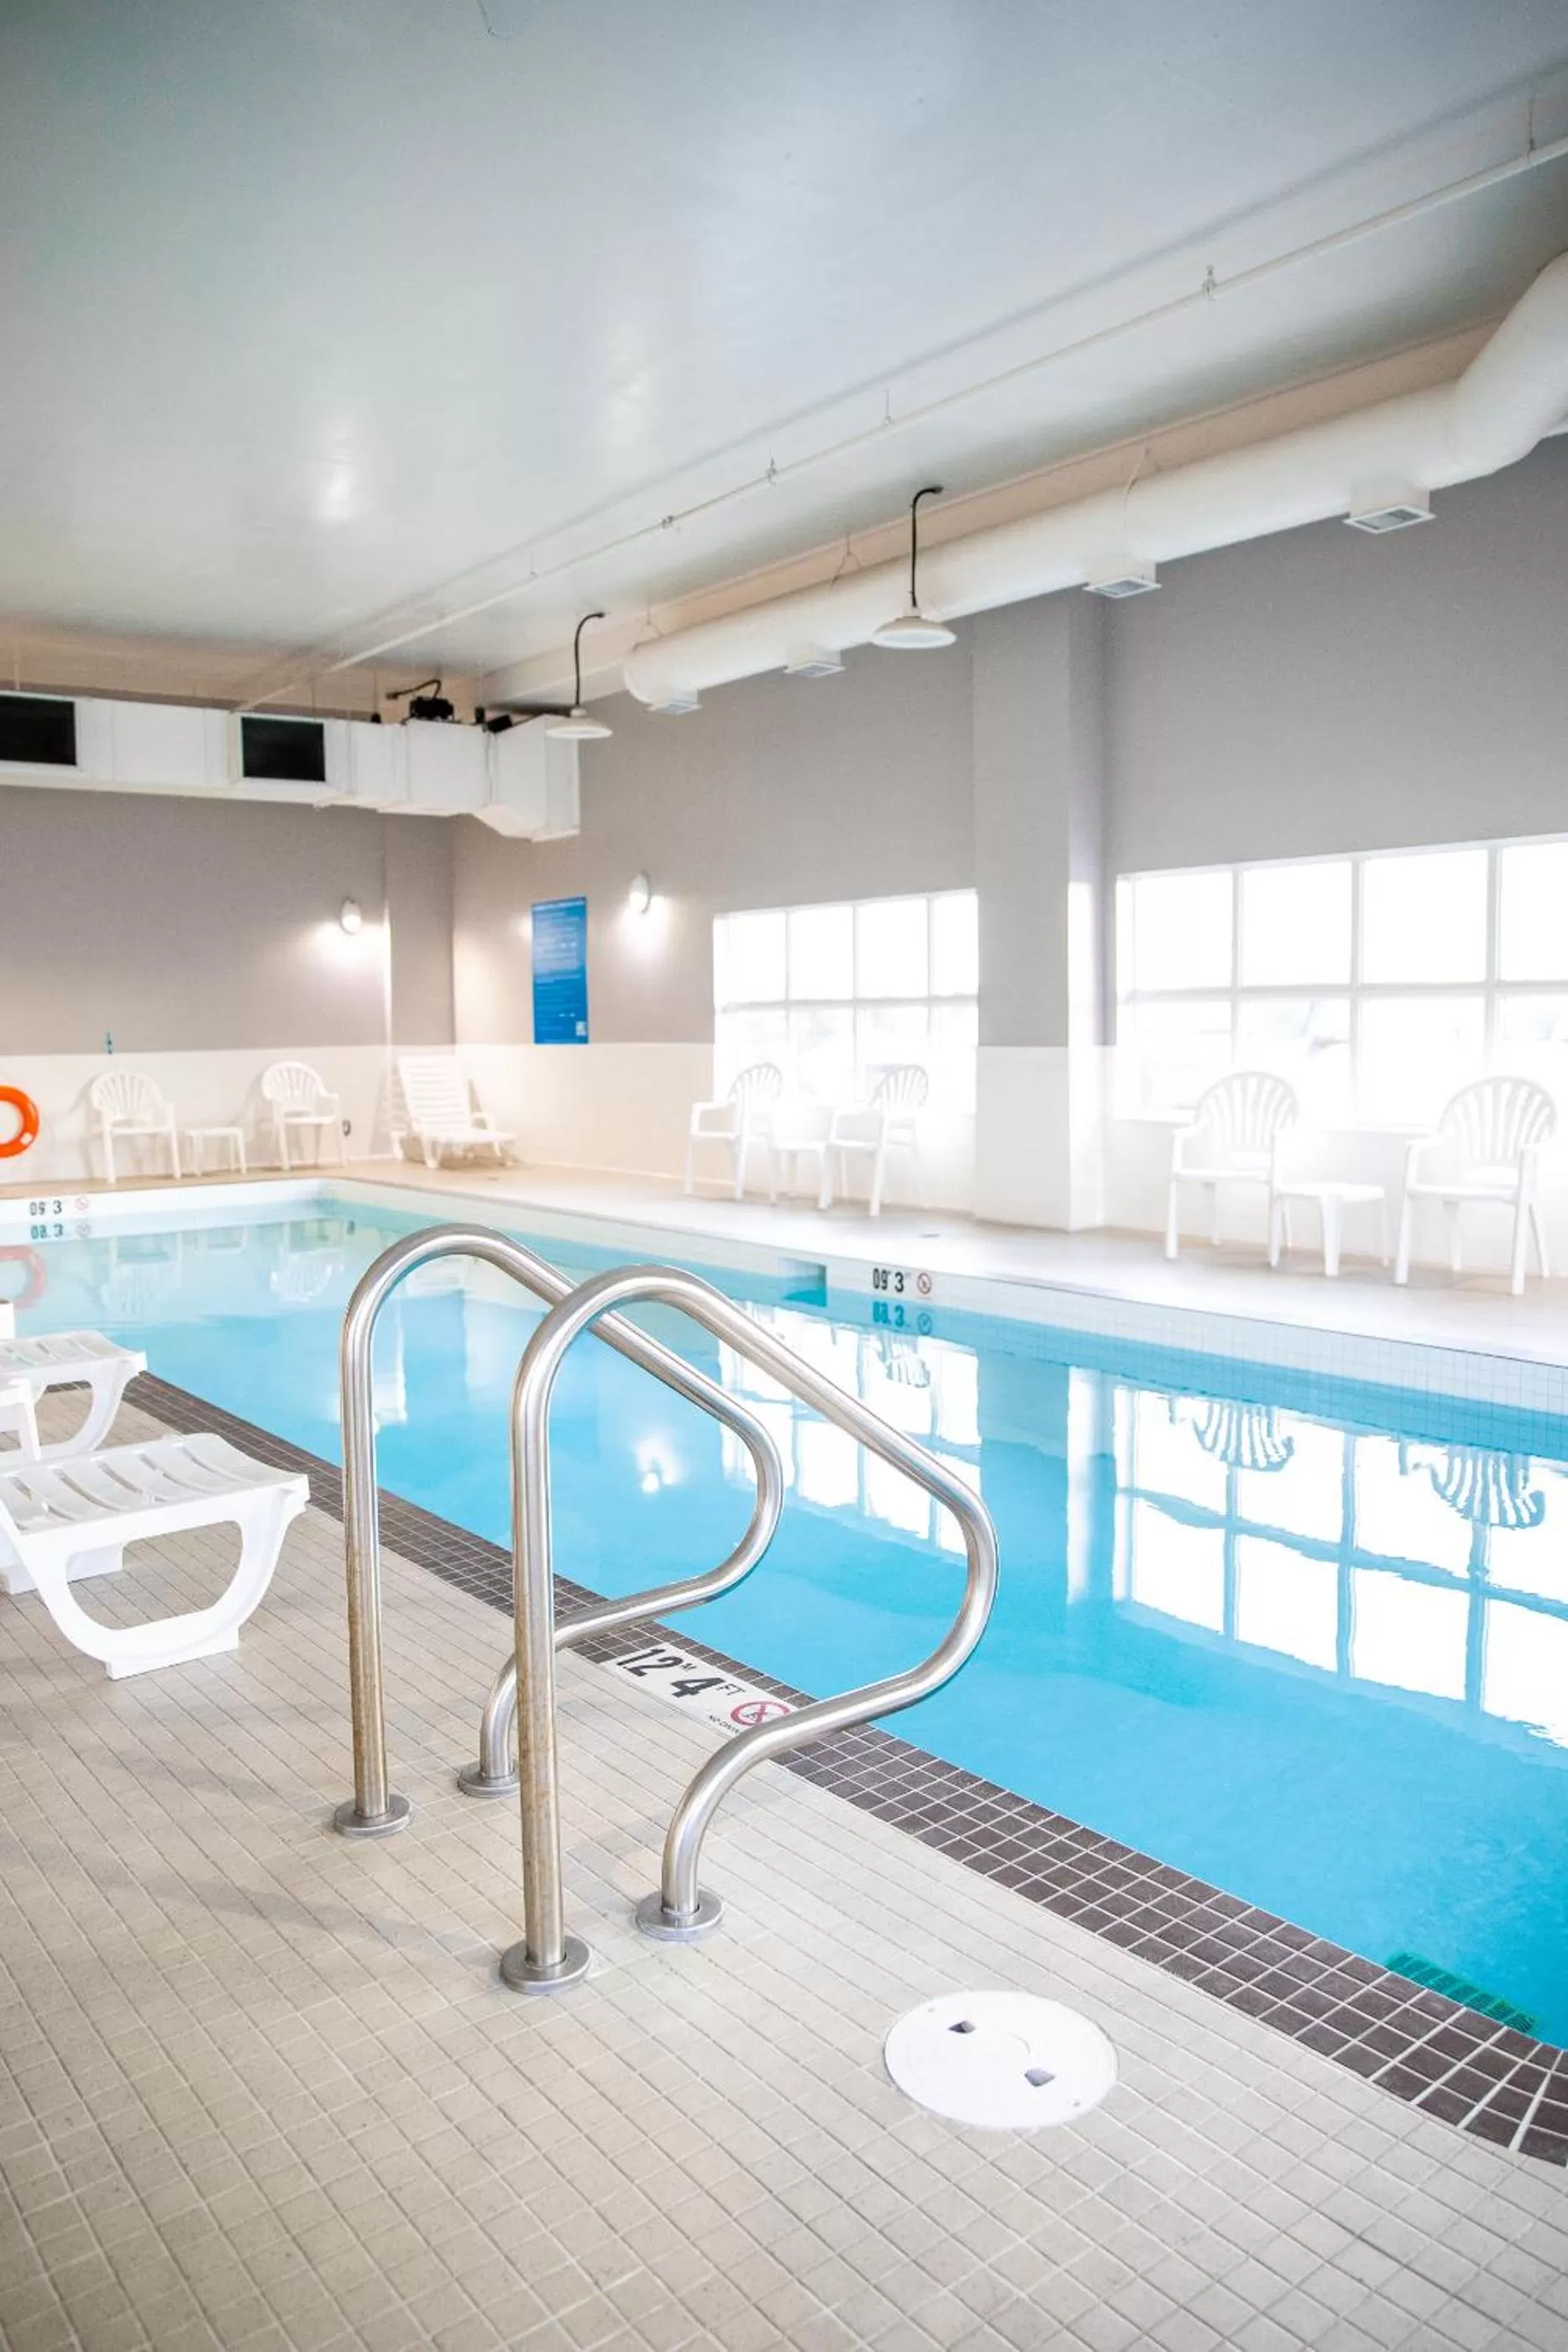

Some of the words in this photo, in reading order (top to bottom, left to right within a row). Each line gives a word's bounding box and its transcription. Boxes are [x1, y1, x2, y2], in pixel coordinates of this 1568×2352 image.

[53, 1200, 62, 1215] 3
[894, 1271, 905, 1293] 3
[670, 1677, 726, 1698] 4
